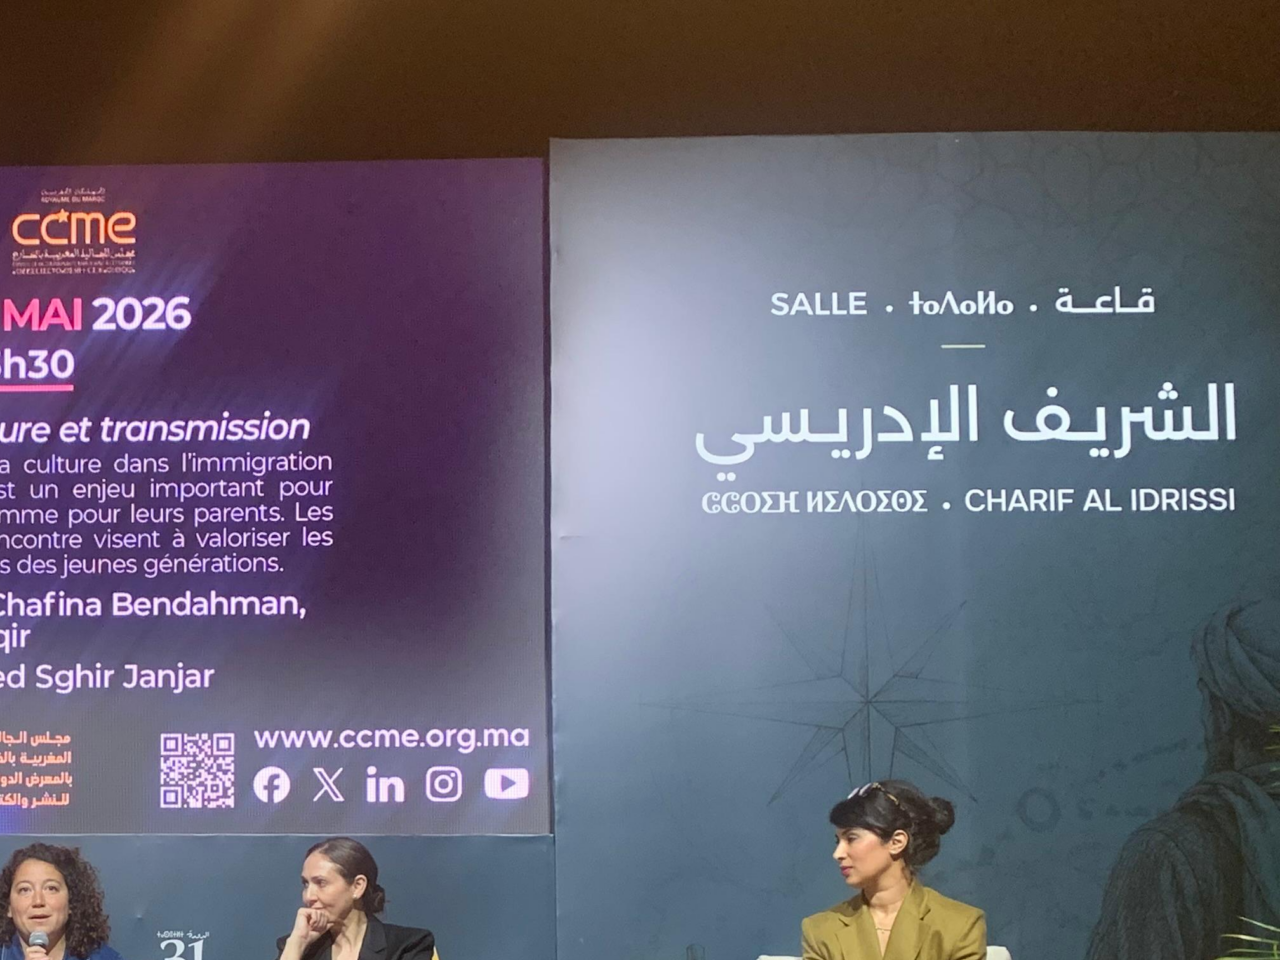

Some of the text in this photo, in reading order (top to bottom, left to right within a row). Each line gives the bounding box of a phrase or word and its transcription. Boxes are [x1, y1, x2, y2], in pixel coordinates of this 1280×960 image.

[770, 292, 868, 317] SALLE
[1055, 286, 1156, 315] قاعة
[3, 298, 83, 332] MAI
[92, 296, 192, 331] 2026
[59, 417, 92, 444] et
[100, 411, 311, 443] transmission
[695, 381, 1237, 483] الشريف الإدريسي
[24, 454, 102, 474] culture
[114, 454, 170, 474] dans
[182, 452, 333, 477] l'immigration
[29, 484, 59, 500] un
[73, 481, 136, 503] enjeu
[150, 479, 265, 503] important
[279, 480, 334, 502] pour
[964, 487, 1236, 513] CHARIF AL IDRISSI
[68, 507, 121, 529] pour
[131, 503, 185, 524] leurs
[194, 505, 286, 528] parents.
[296, 502, 334, 522] Les
[94, 529, 161, 549] visent
[172, 529, 186, 548] à
[196, 527, 291, 548] valoriser
[302, 526, 334, 547] les
[17, 554, 57, 575] des
[60, 555, 138, 579] jeunes
[144, 553, 285, 578] générations.
[112, 590, 307, 620] Bendahman,
[35, 663, 115, 694] Sghir
[123, 662, 215, 694] Janjar
[31, 731, 71, 746] مجلس
[254, 728, 530, 755] www.ccme.org.ma
[25, 771, 73, 788] بالمعرض
